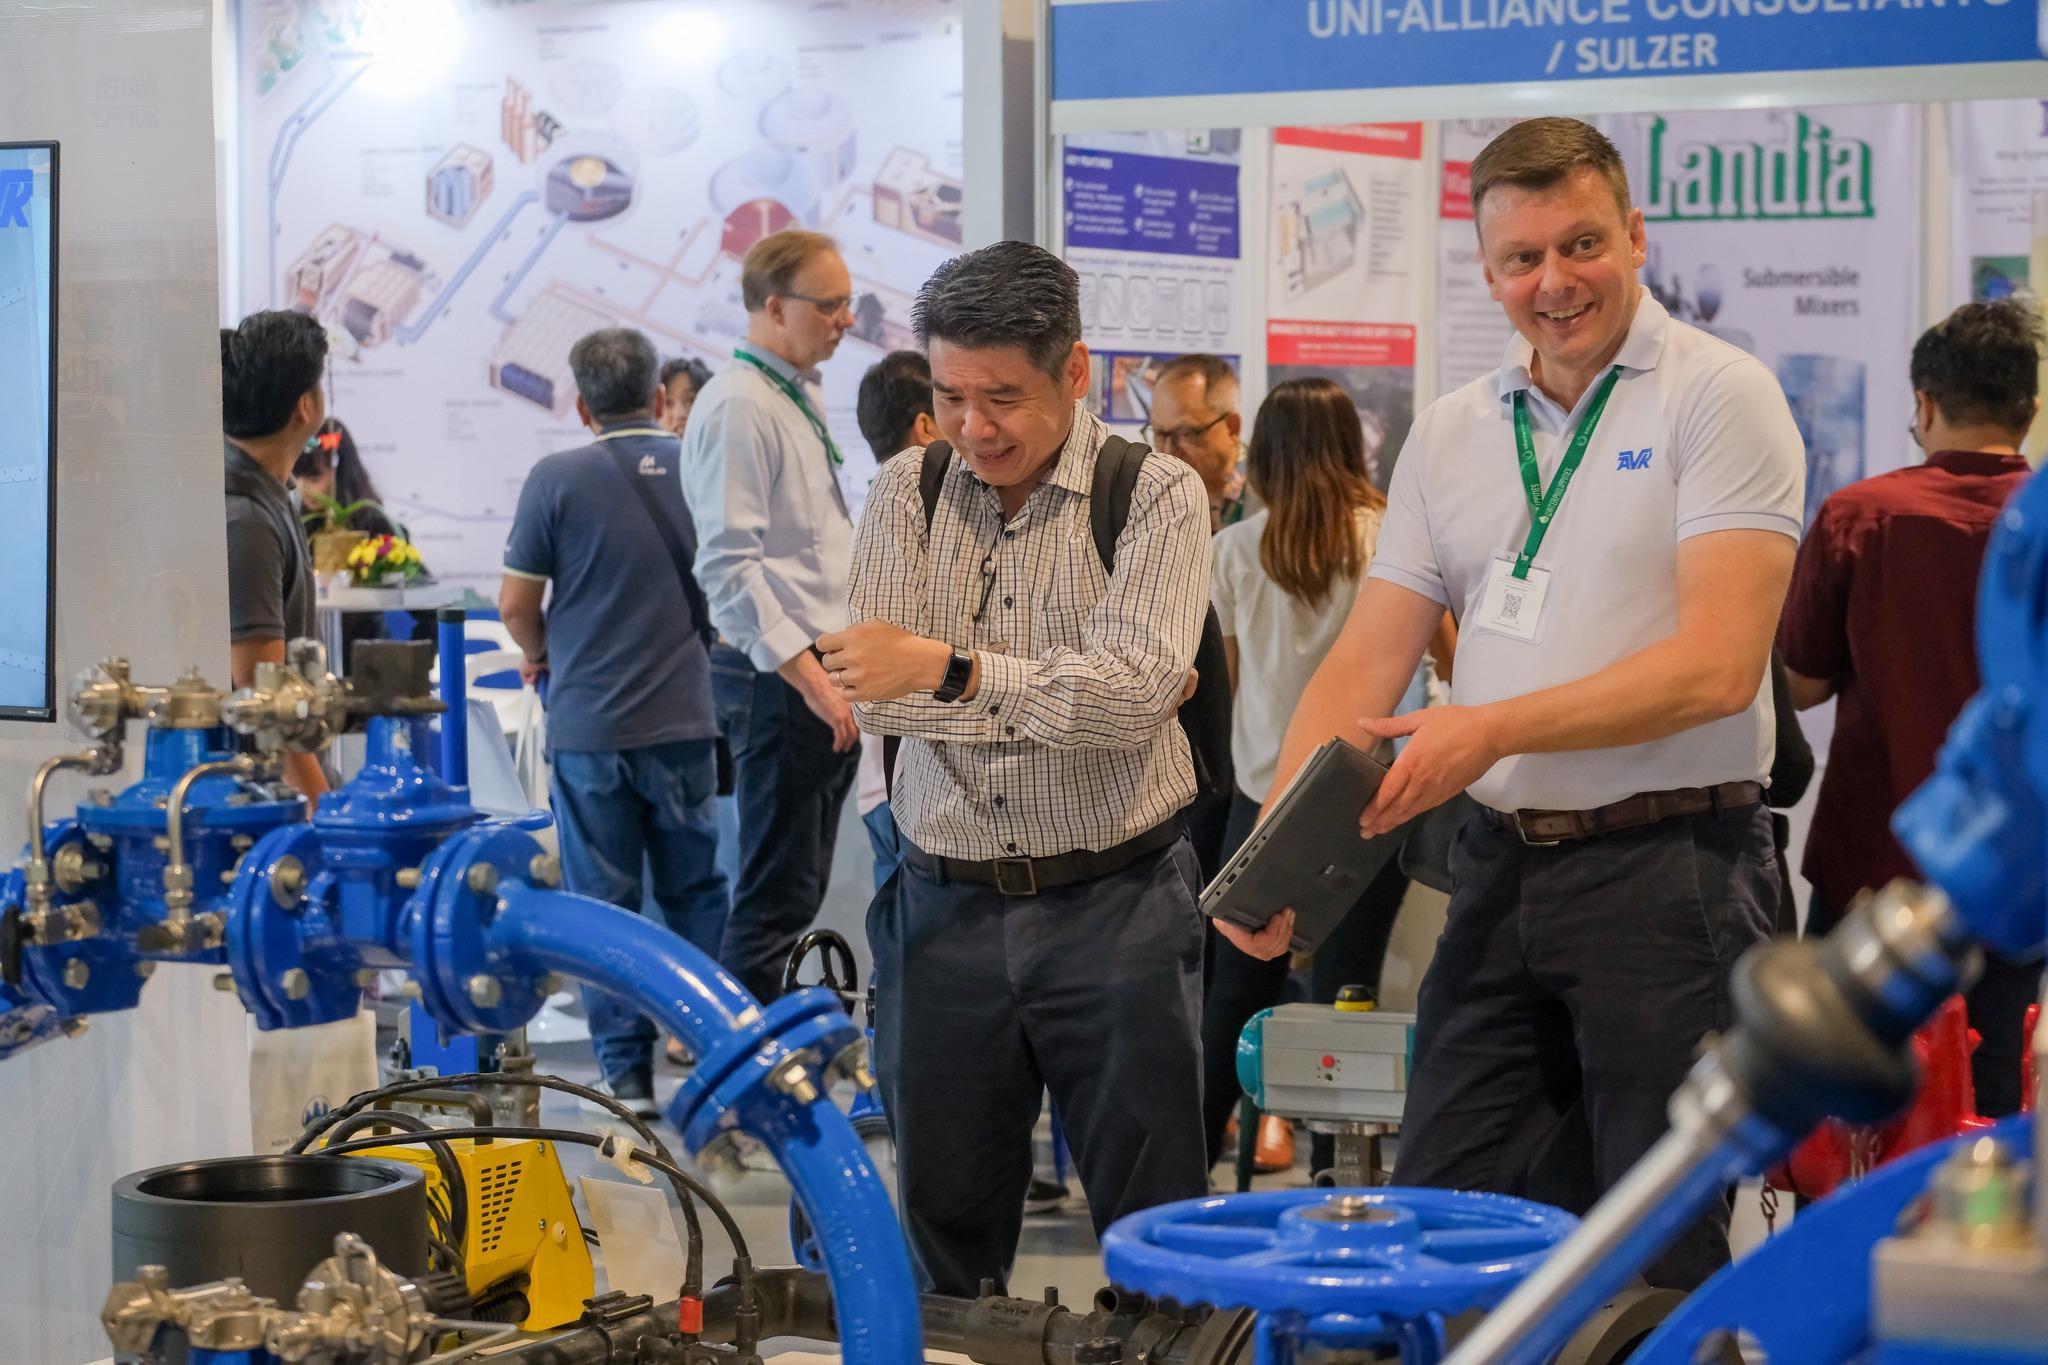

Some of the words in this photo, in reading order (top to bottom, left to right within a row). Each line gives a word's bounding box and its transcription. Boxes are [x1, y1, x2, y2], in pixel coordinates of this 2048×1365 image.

[1308, 0, 1631, 37] UNI-ALLIANCE
[1576, 33, 1718, 73] SULZER
[1632, 111, 1875, 222] Landia
[1743, 265, 1859, 289] Submersible
[1795, 296, 1859, 317] Mixers
